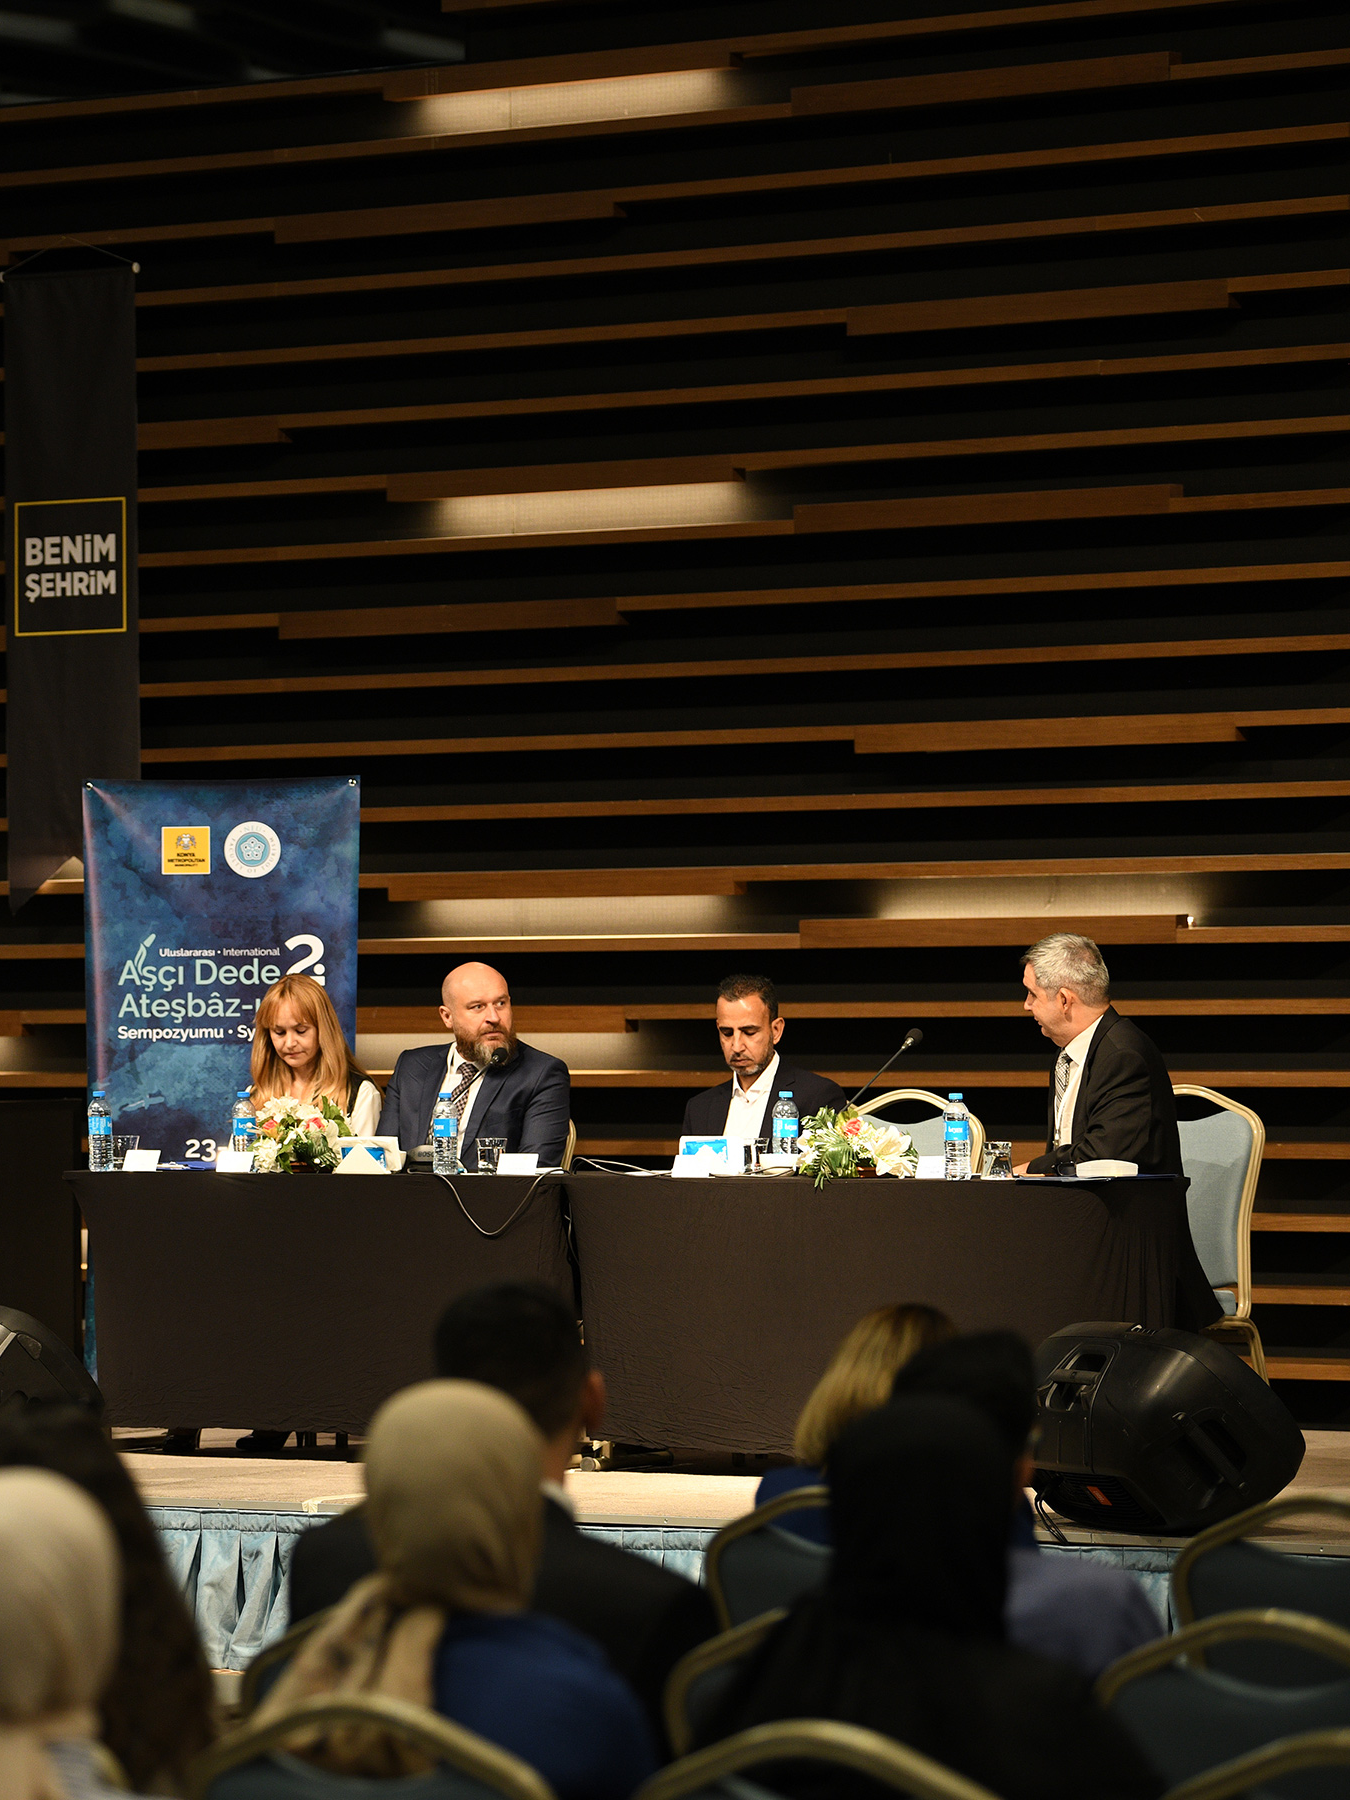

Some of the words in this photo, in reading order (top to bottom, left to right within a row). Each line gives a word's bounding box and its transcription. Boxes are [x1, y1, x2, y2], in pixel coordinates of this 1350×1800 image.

[159, 947, 215, 957] Uluslararası
[222, 947, 280, 957] International
[117, 960, 184, 991] Aşçı
[195, 958, 281, 986] Dede
[117, 1025, 224, 1042] Sempozyumu
